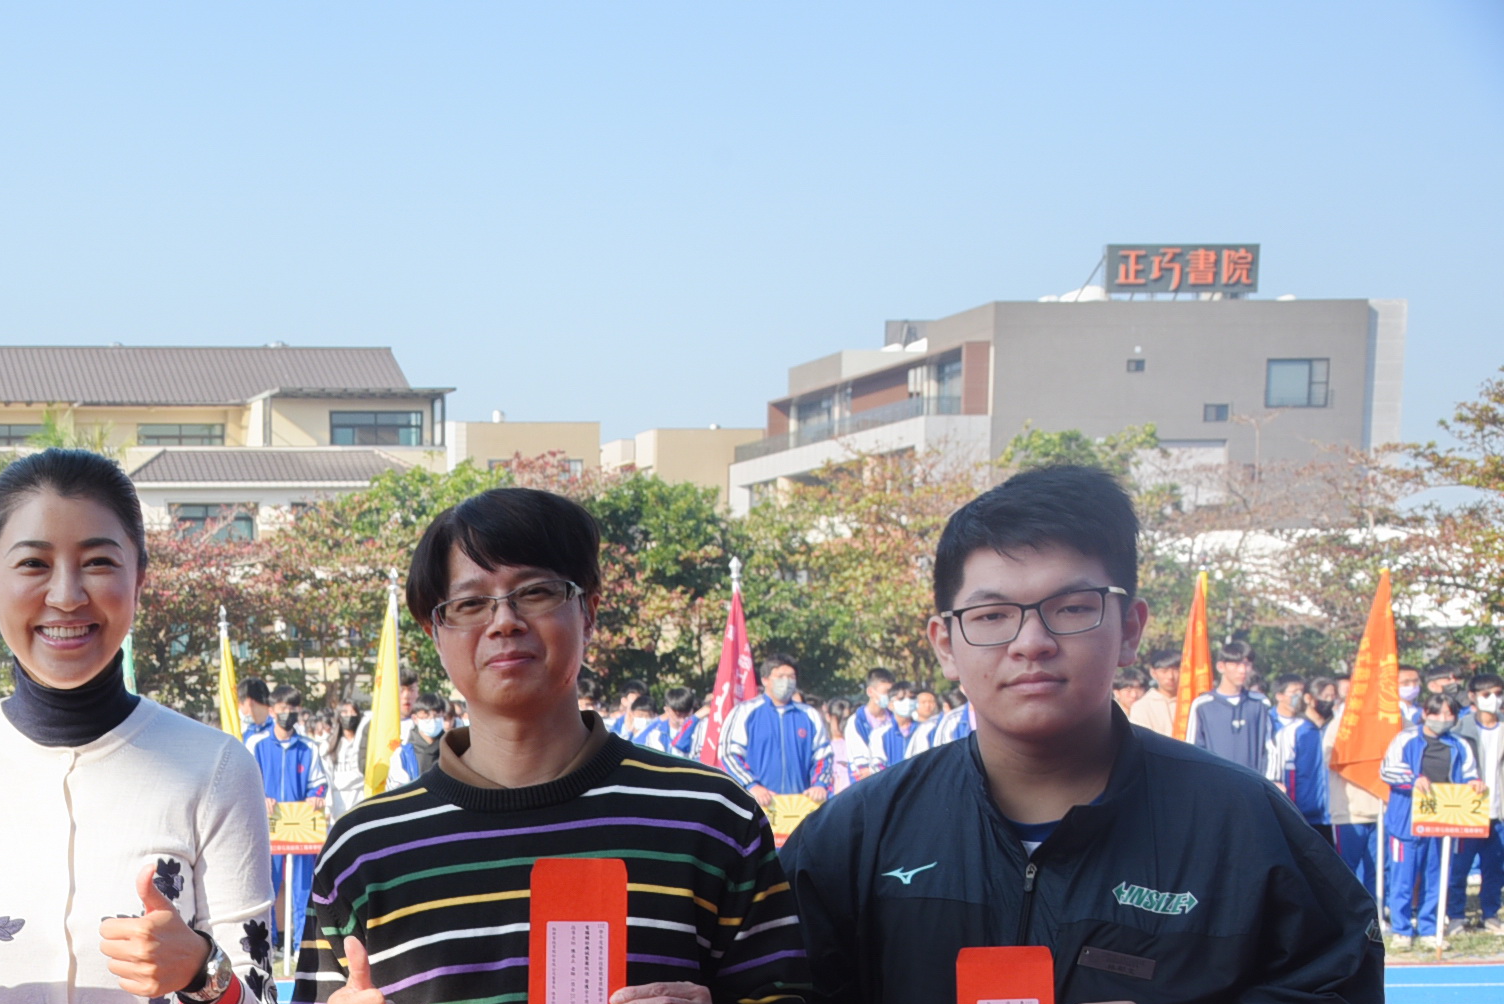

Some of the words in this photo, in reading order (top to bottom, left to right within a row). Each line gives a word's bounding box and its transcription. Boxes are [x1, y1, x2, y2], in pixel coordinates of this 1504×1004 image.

[1115, 248, 1253, 291] 正巧書院
[1124, 884, 1185, 915] INSIZE
